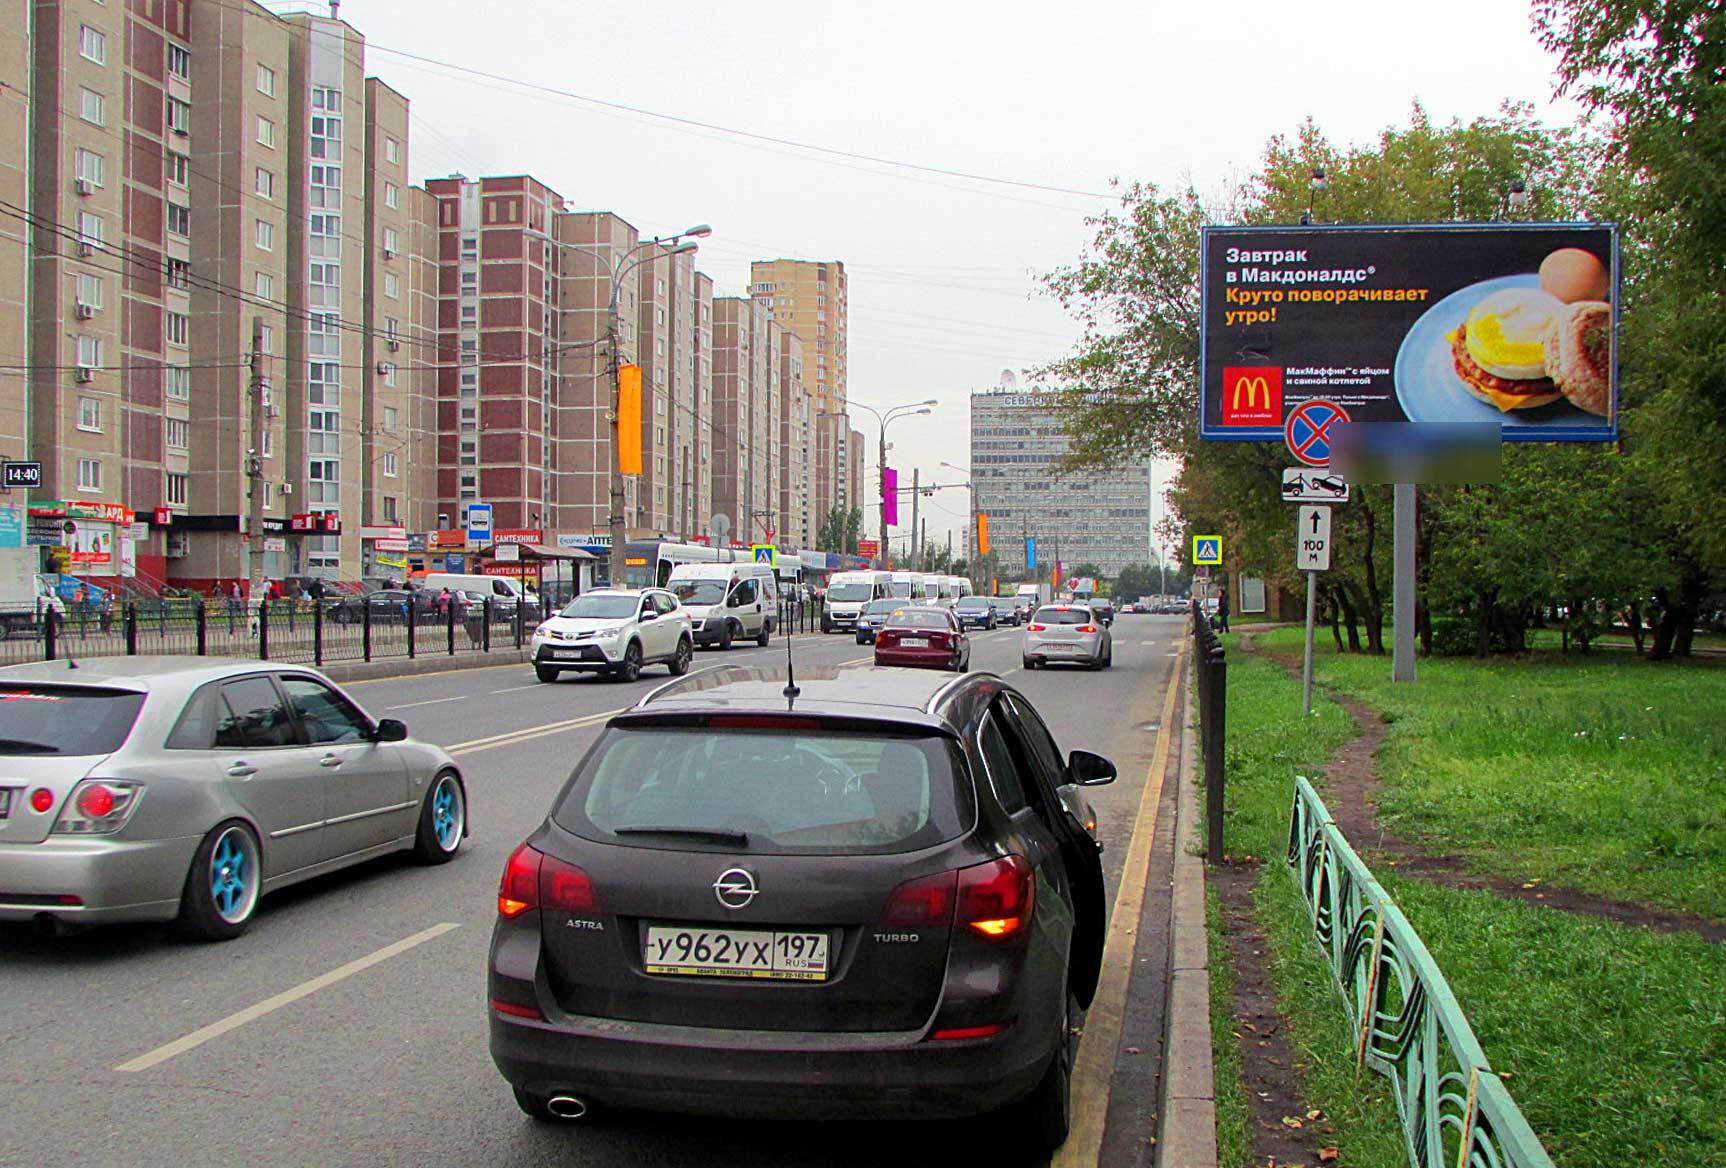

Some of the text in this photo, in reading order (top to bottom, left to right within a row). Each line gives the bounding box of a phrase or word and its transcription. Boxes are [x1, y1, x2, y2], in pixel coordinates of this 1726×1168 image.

[1226, 248, 1307, 265] Завтрак
[1226, 271, 1237, 282] в
[1226, 288, 1429, 305] Круто поворачивает
[1225, 307, 1277, 325] утро!
[1359, 368, 1390, 376] яйцом
[1294, 377, 1327, 385] свиной
[1329, 377, 1371, 385] котлетой
[8, 468, 38, 481] 14:40
[494, 534, 539, 543] САНТЕХНИКА
[587, 536, 612, 545] АПТЕ
[1303, 541, 1324, 551] 100
[566, 919, 604, 931] ASTRA
[873, 933, 919, 943] TURBO
[777, 935, 820, 959] 197
[786, 958, 807, 968] RUS
